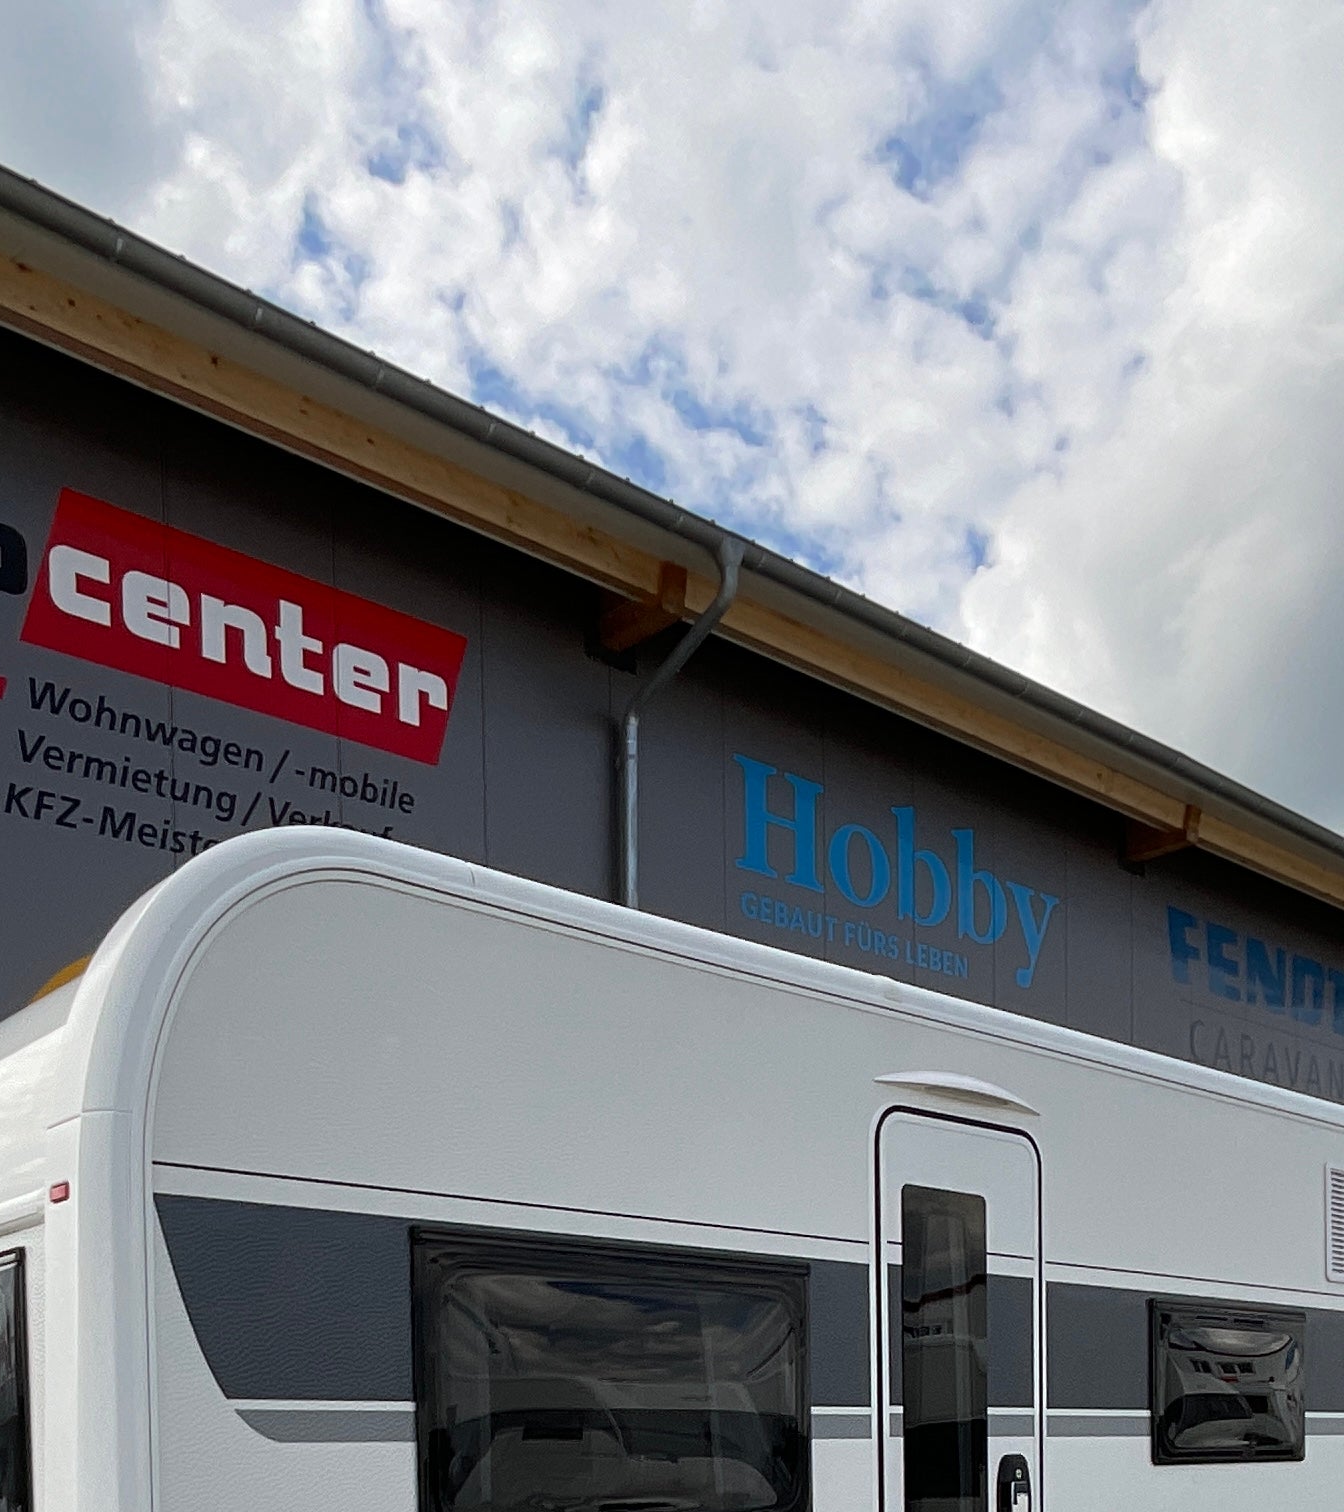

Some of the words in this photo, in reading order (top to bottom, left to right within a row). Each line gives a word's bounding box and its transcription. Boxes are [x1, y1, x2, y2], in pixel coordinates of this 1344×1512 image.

[28, 677, 265, 773] Wohnwagen
[17, 730, 238, 822] Vermietung
[733, 753, 1060, 988] Hobby
[740, 892, 838, 943] GEBAUT
[843, 920, 900, 961] FÜRS
[905, 939, 969, 980] LEBEN
[1189, 1018, 1344, 1099] CARAVAN
